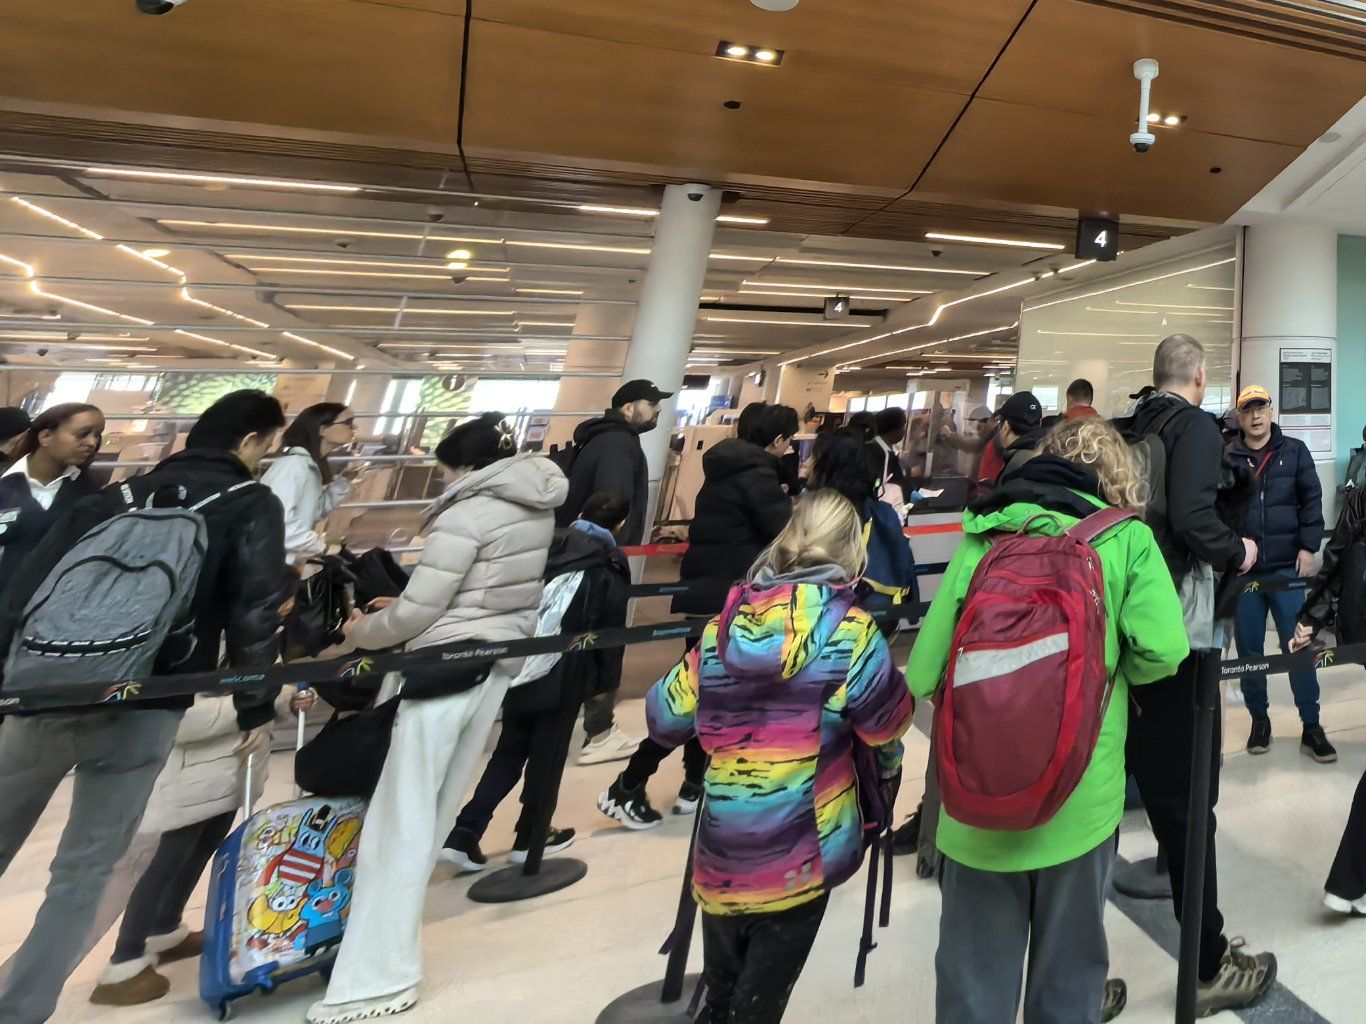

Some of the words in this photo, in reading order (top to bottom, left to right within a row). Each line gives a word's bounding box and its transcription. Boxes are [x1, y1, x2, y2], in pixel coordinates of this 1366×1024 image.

[1094, 230, 1107, 248] 4
[834, 301, 843, 313] 4
[1221, 665, 1246, 676] Toronto
[1245, 662, 1270, 673] Pearson
